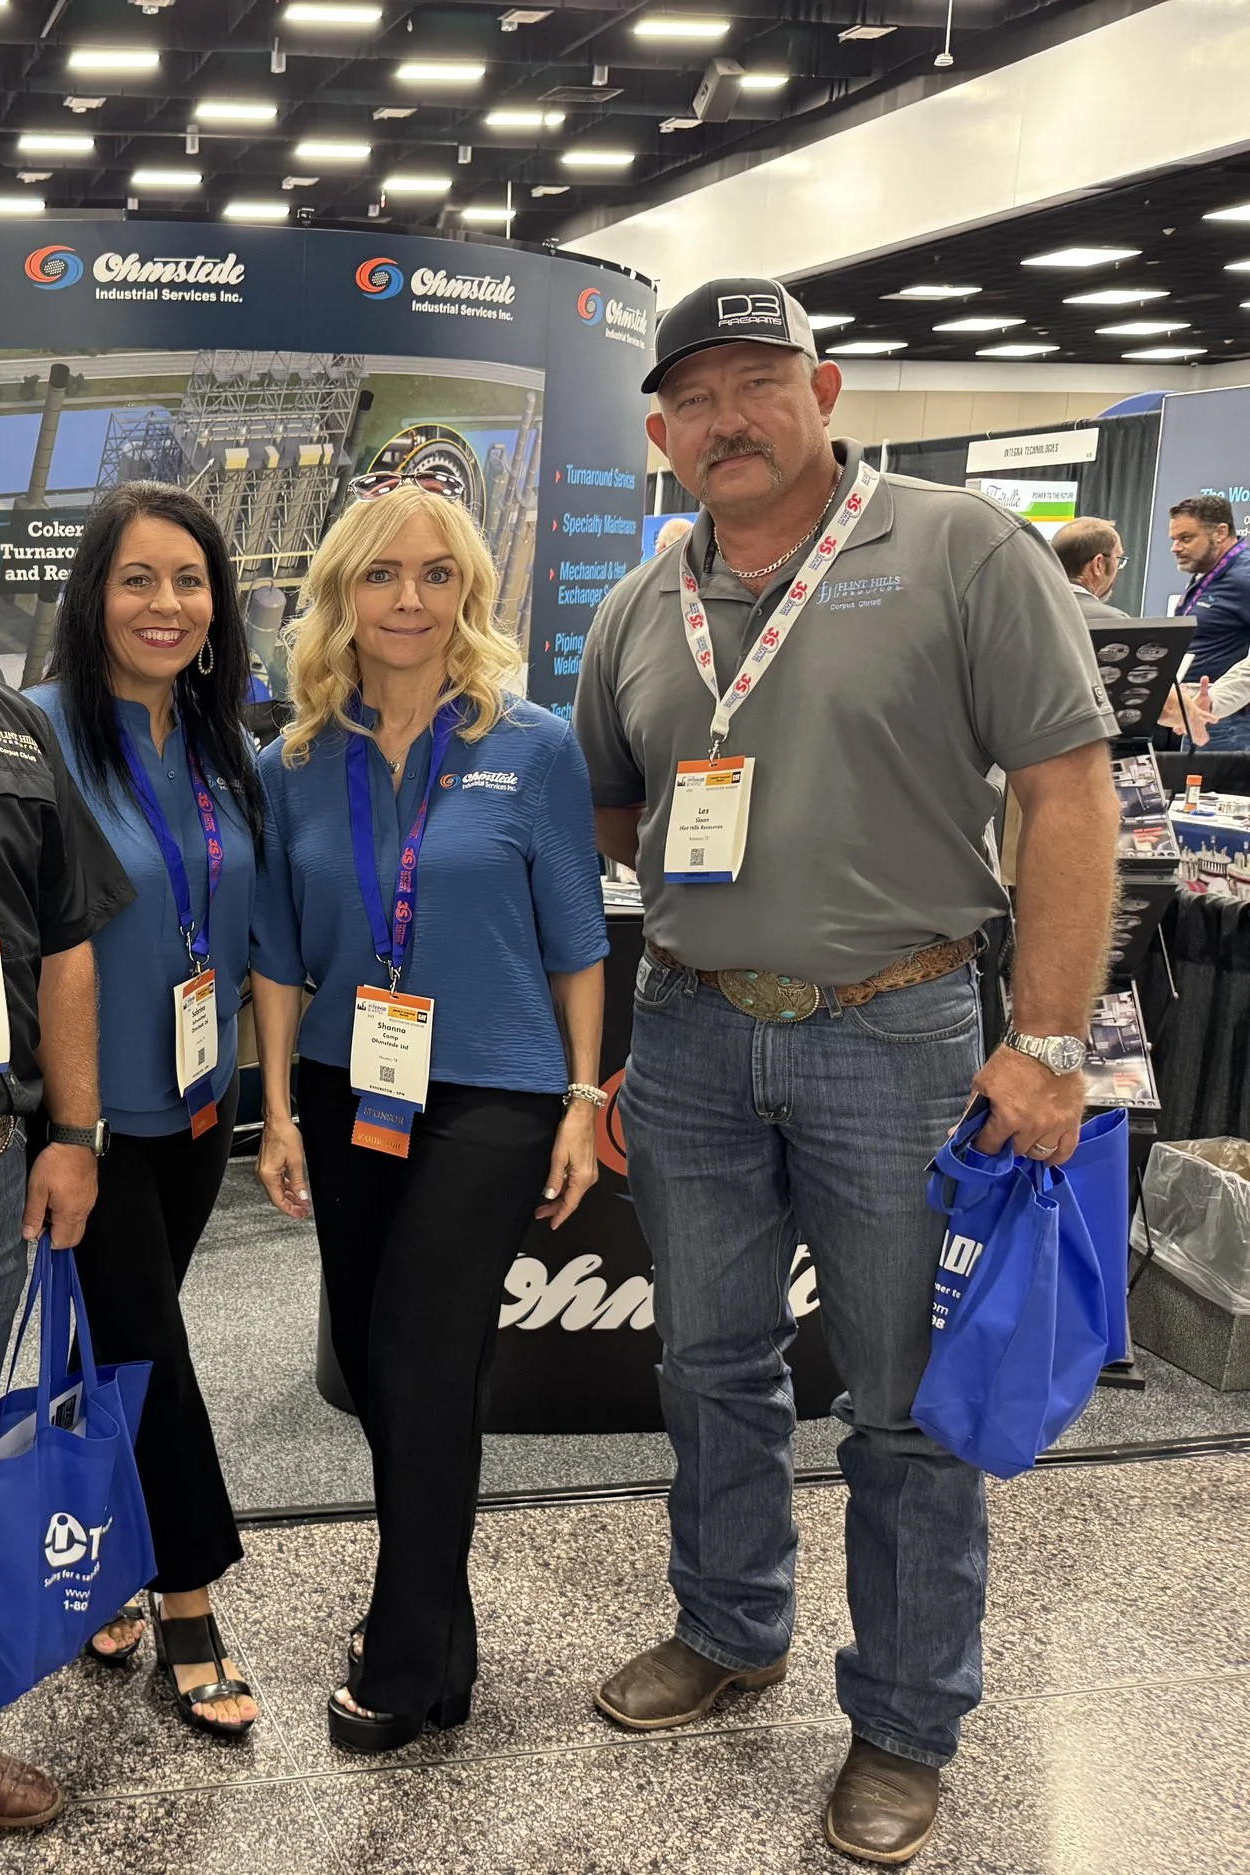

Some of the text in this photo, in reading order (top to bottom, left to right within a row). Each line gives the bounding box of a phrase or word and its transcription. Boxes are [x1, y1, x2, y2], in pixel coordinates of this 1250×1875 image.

[93, 252, 245, 285] Ohmstede
[411, 267, 516, 304] Ohmstede
[95, 288, 243, 303] Industrial Services Inc.
[412, 300, 513, 321] Industrial Services Inc.
[717, 294, 780, 319] D3
[718, 316, 782, 327] FIREARMS
[1004, 443, 1059, 457] INTEGRA TECHNOLOGIES
[566, 463, 636, 489] Turnaround Services
[1229, 487, 1250, 502] Wo
[28, 522, 84, 537] Coker
[563, 512, 636, 537] Specialty Maintenance
[5, 566, 39, 580] and
[559, 561, 607, 581] Mechanical
[607, 564, 613, 580] &
[836, 585, 905, 597] resources
[838, 576, 901, 592] FLINT HILLS
[558, 585, 602, 607] Exchanger
[830, 598, 881, 610] Corpus Christi
[555, 632, 584, 653] Piping
[462, 771, 518, 785] Ohmstede
[462, 781, 485, 789] Industrial
[485, 782, 506, 790] Services
[377, 1022, 406, 1034] Shanna
[371, 1038, 399, 1048] Ohmstede
[383, 1033, 399, 1041] Camp
[364, 1107, 404, 1125] SPONSOR
[62, 1569, 74, 1578] for
